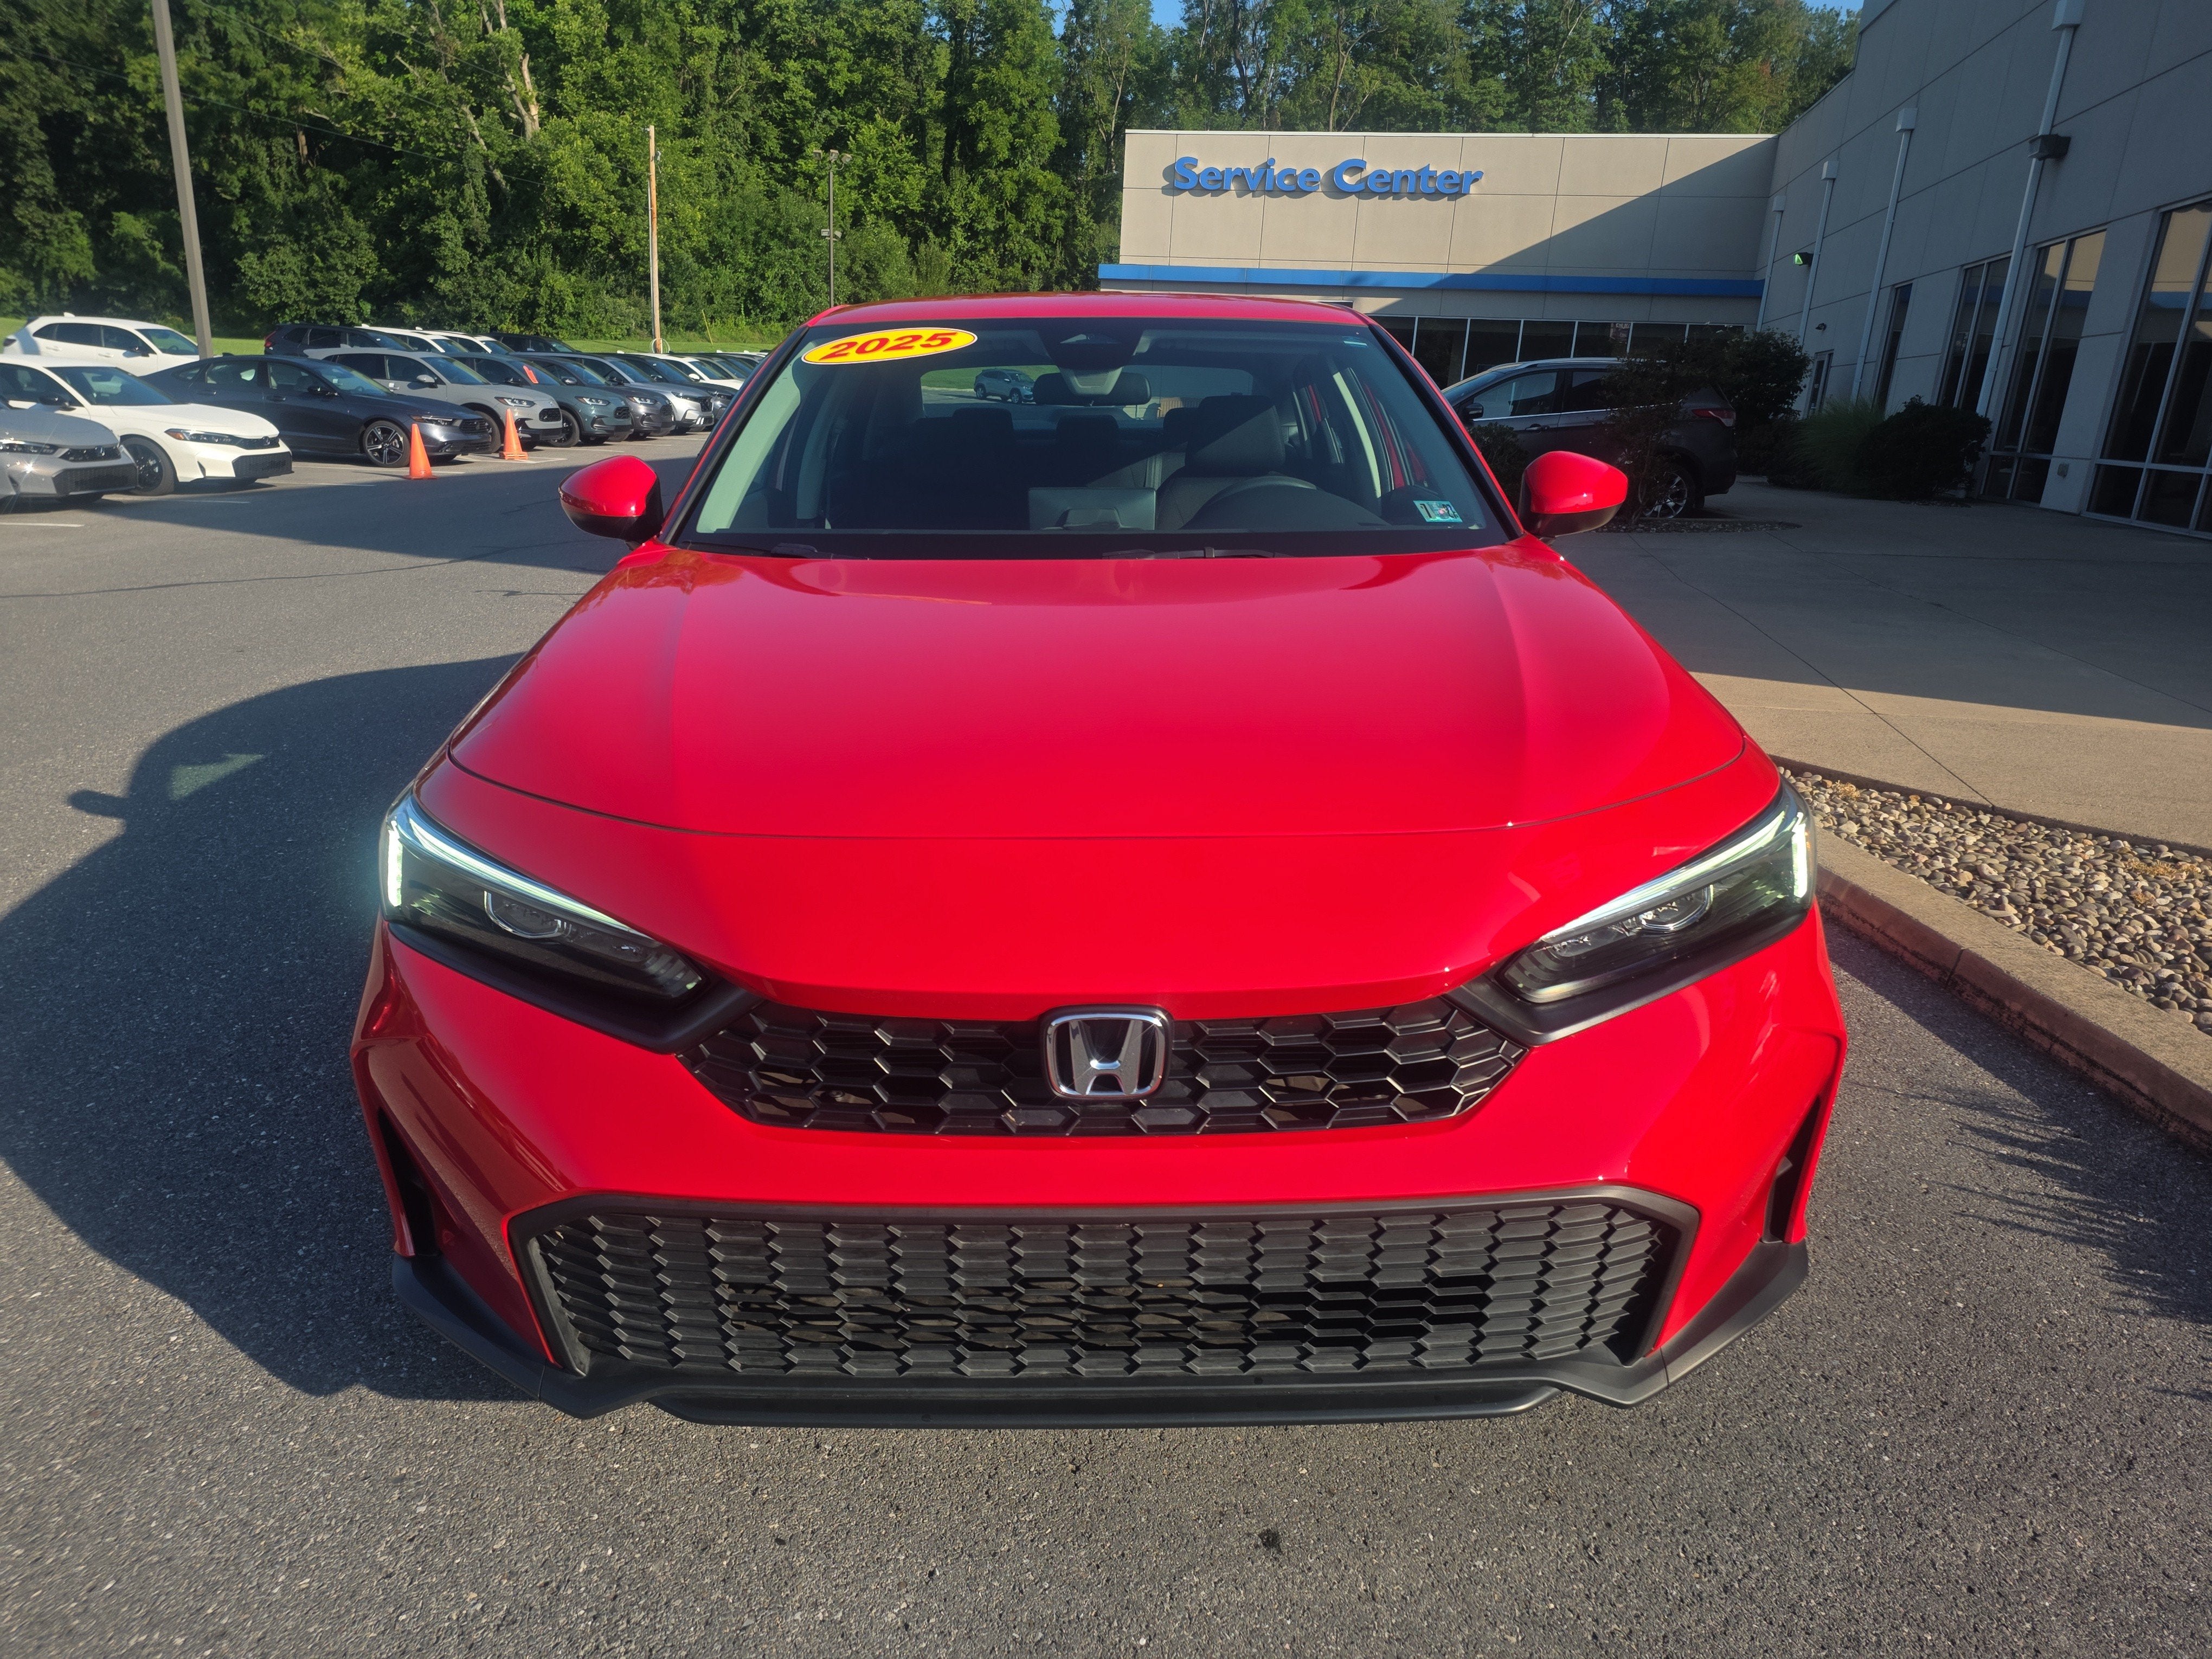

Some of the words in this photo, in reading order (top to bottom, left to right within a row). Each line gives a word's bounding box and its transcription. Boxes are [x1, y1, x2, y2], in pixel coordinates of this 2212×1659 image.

[1174, 156, 1321, 191] Service
[1333, 158, 1484, 194] Center
[819, 332, 958, 361] 2025
